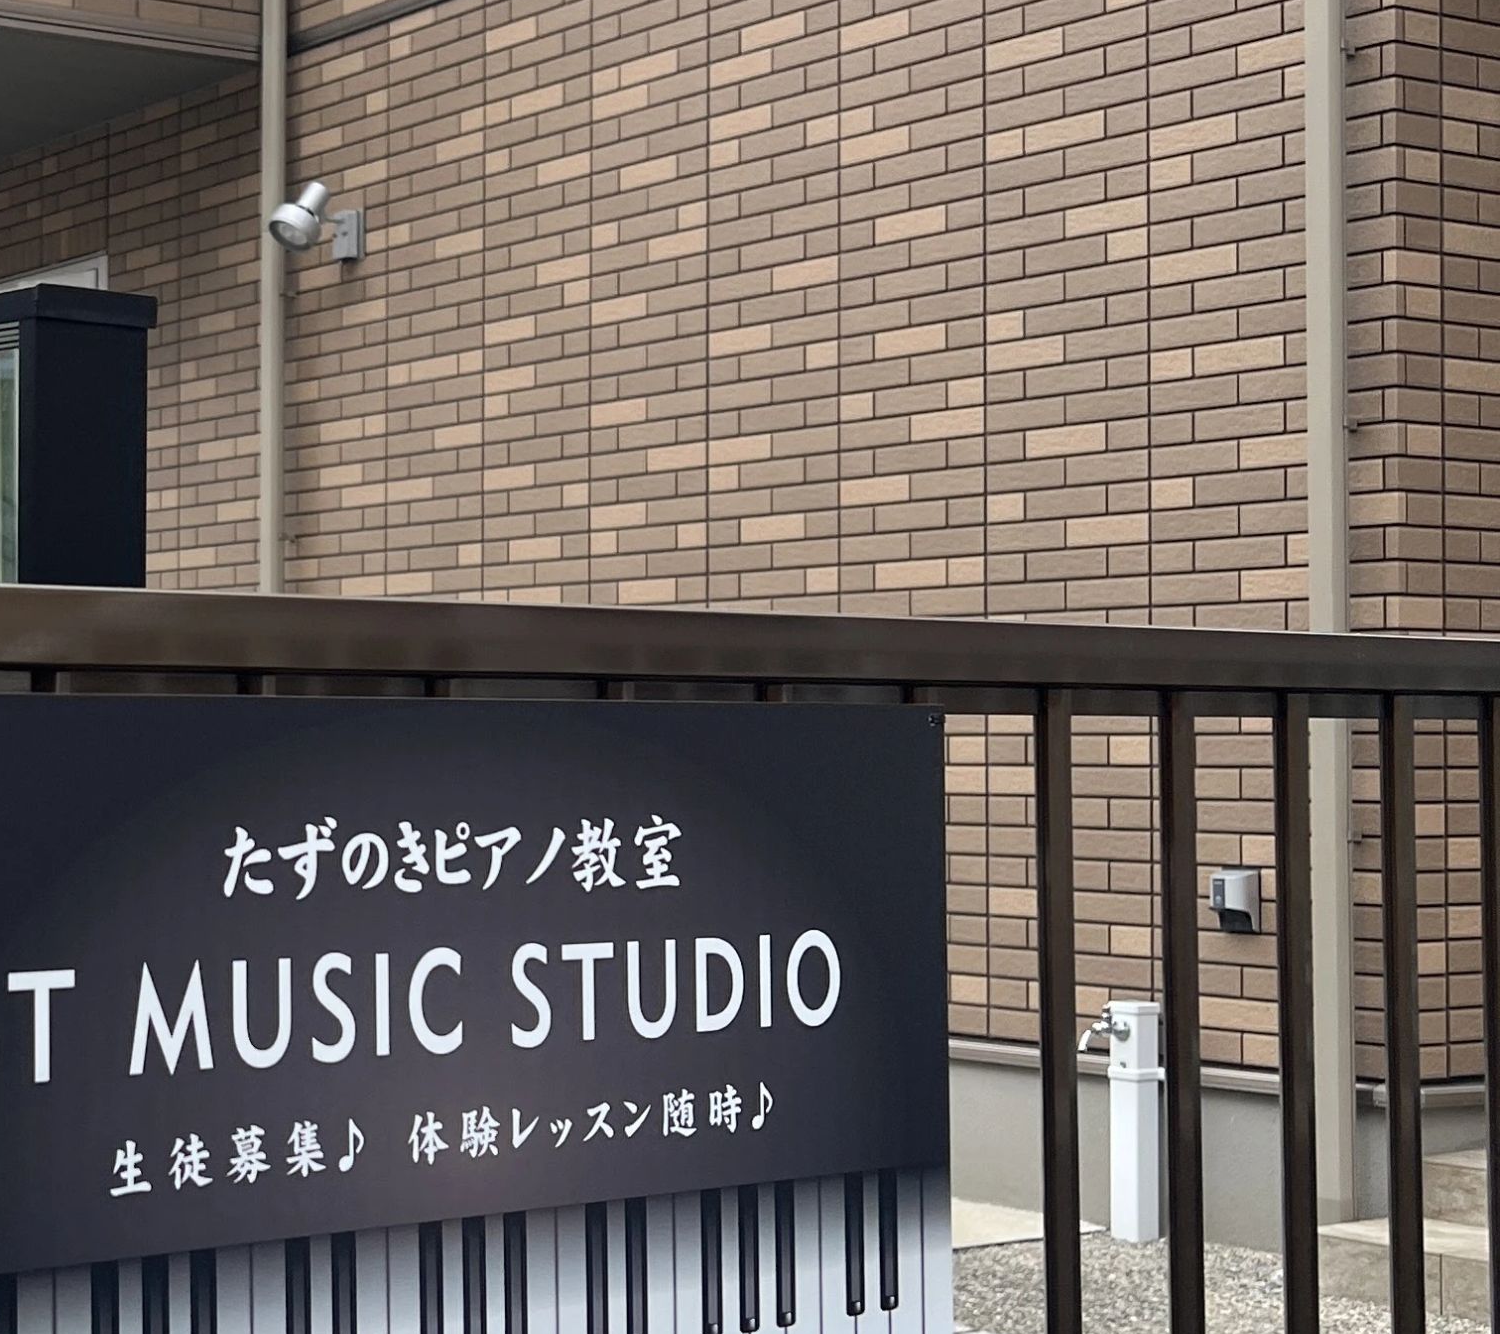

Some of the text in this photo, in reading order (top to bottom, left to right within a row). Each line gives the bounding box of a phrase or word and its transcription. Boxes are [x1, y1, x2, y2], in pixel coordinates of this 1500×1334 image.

[223, 814, 682, 900] たずのきピアノ教室
[7, 929, 841, 1083] T MUSIC STUDIO
